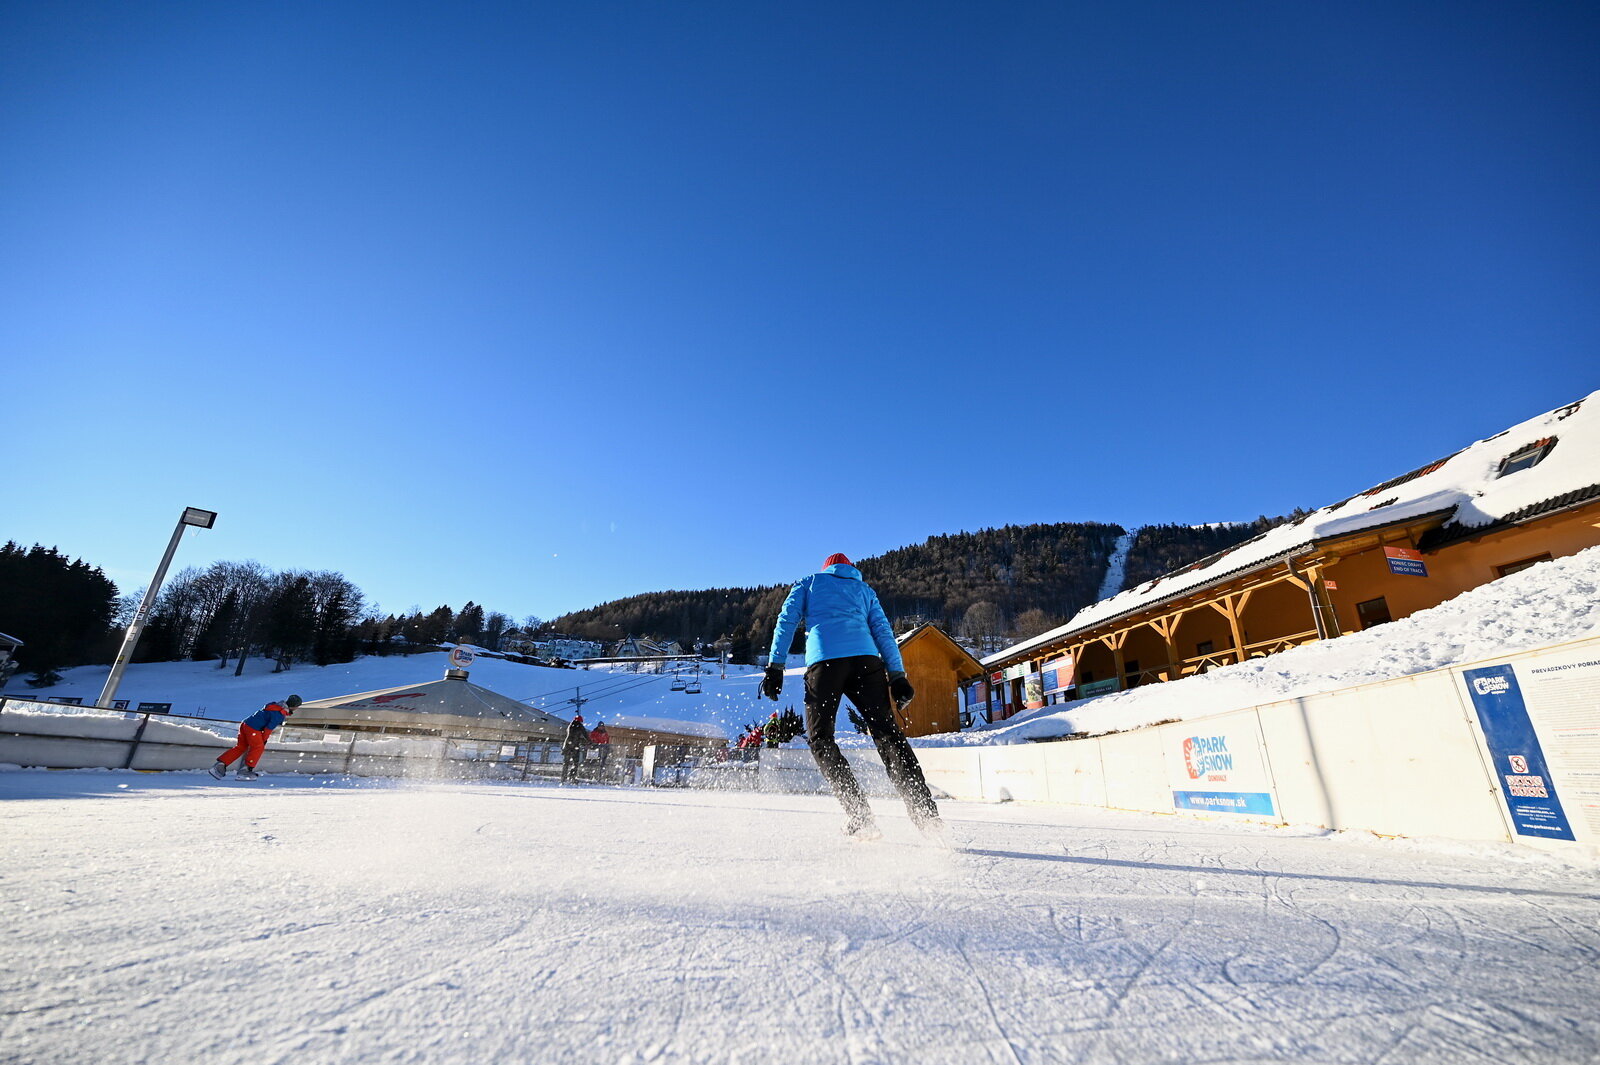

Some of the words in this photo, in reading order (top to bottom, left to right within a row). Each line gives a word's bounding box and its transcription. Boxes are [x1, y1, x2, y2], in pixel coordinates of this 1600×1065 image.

[1486, 676, 1506, 684] PARK
[1490, 682, 1509, 691] SNOW
[1200, 735, 1227, 753] PARK
[1204, 753, 1232, 771] SNOW
